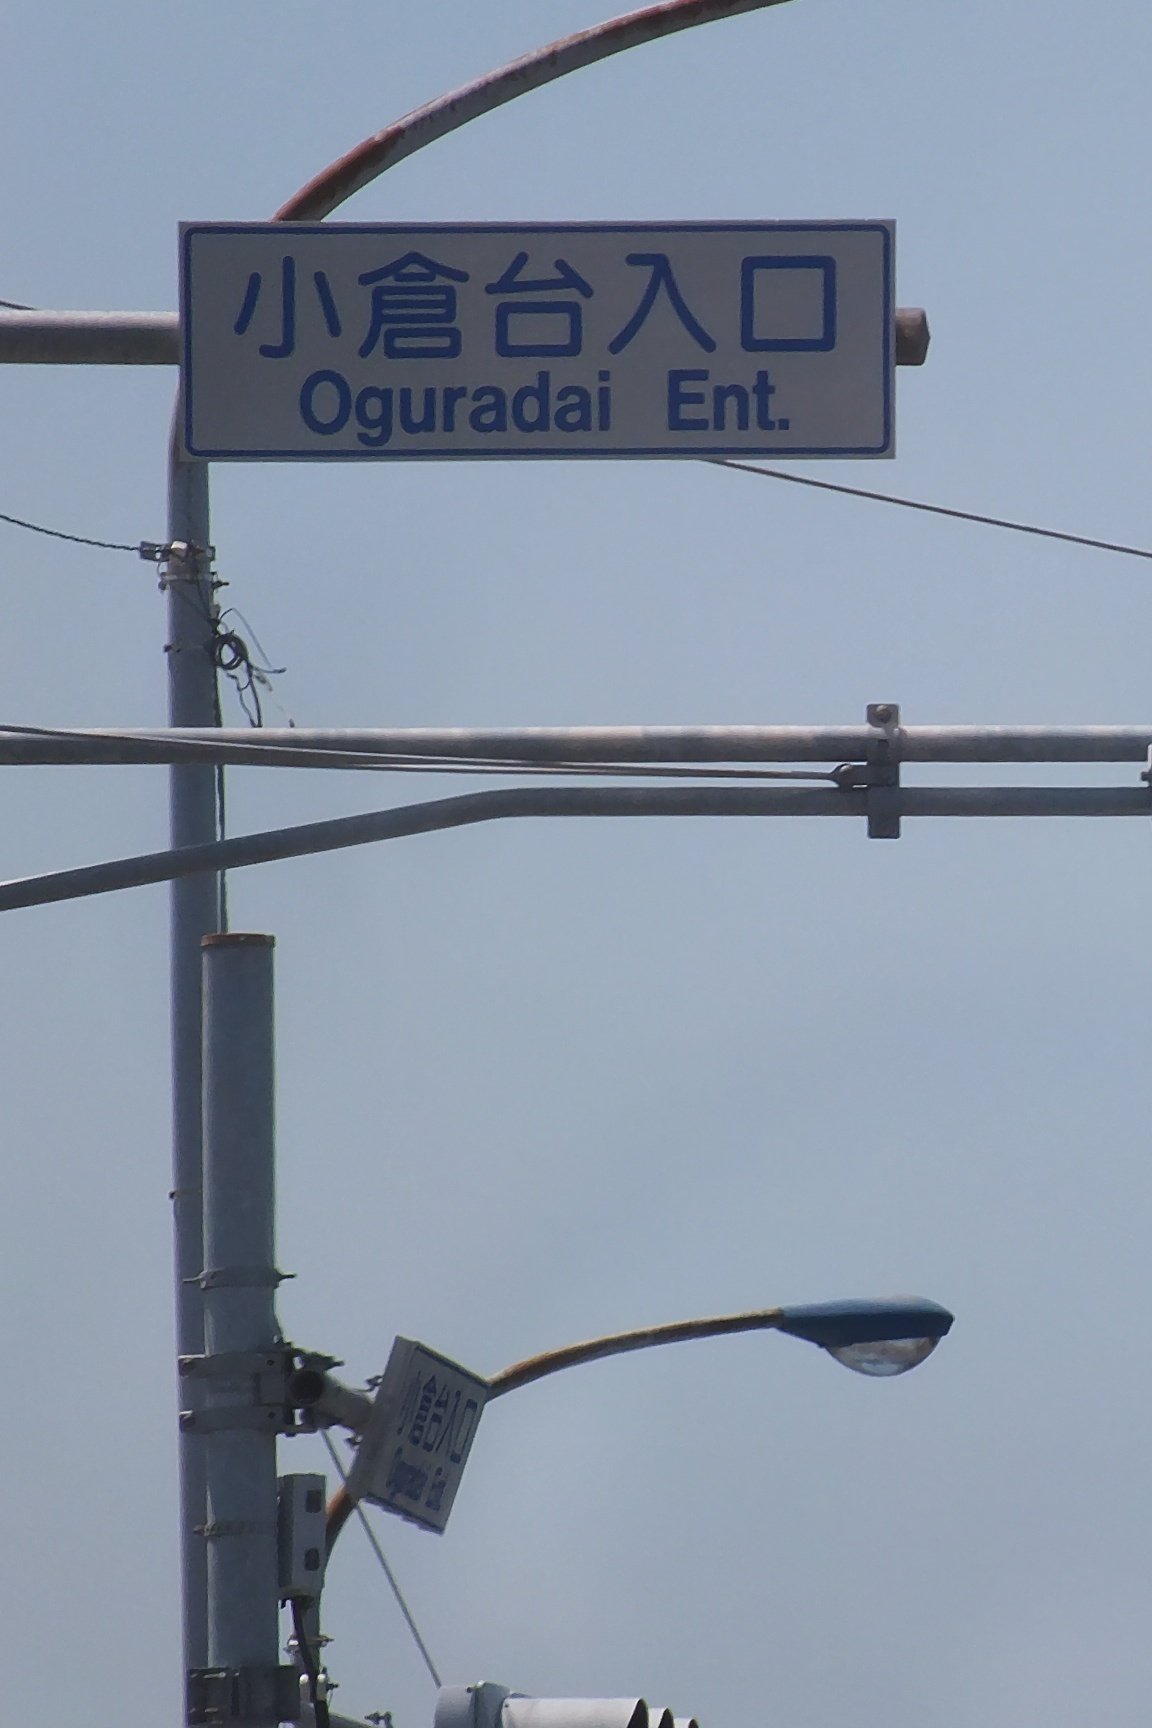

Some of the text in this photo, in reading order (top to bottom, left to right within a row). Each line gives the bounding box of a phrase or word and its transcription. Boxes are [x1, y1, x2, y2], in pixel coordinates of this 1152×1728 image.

[234, 251, 837, 359] 小倉台入口
[300, 369, 791, 447] Oguradai Ent.
